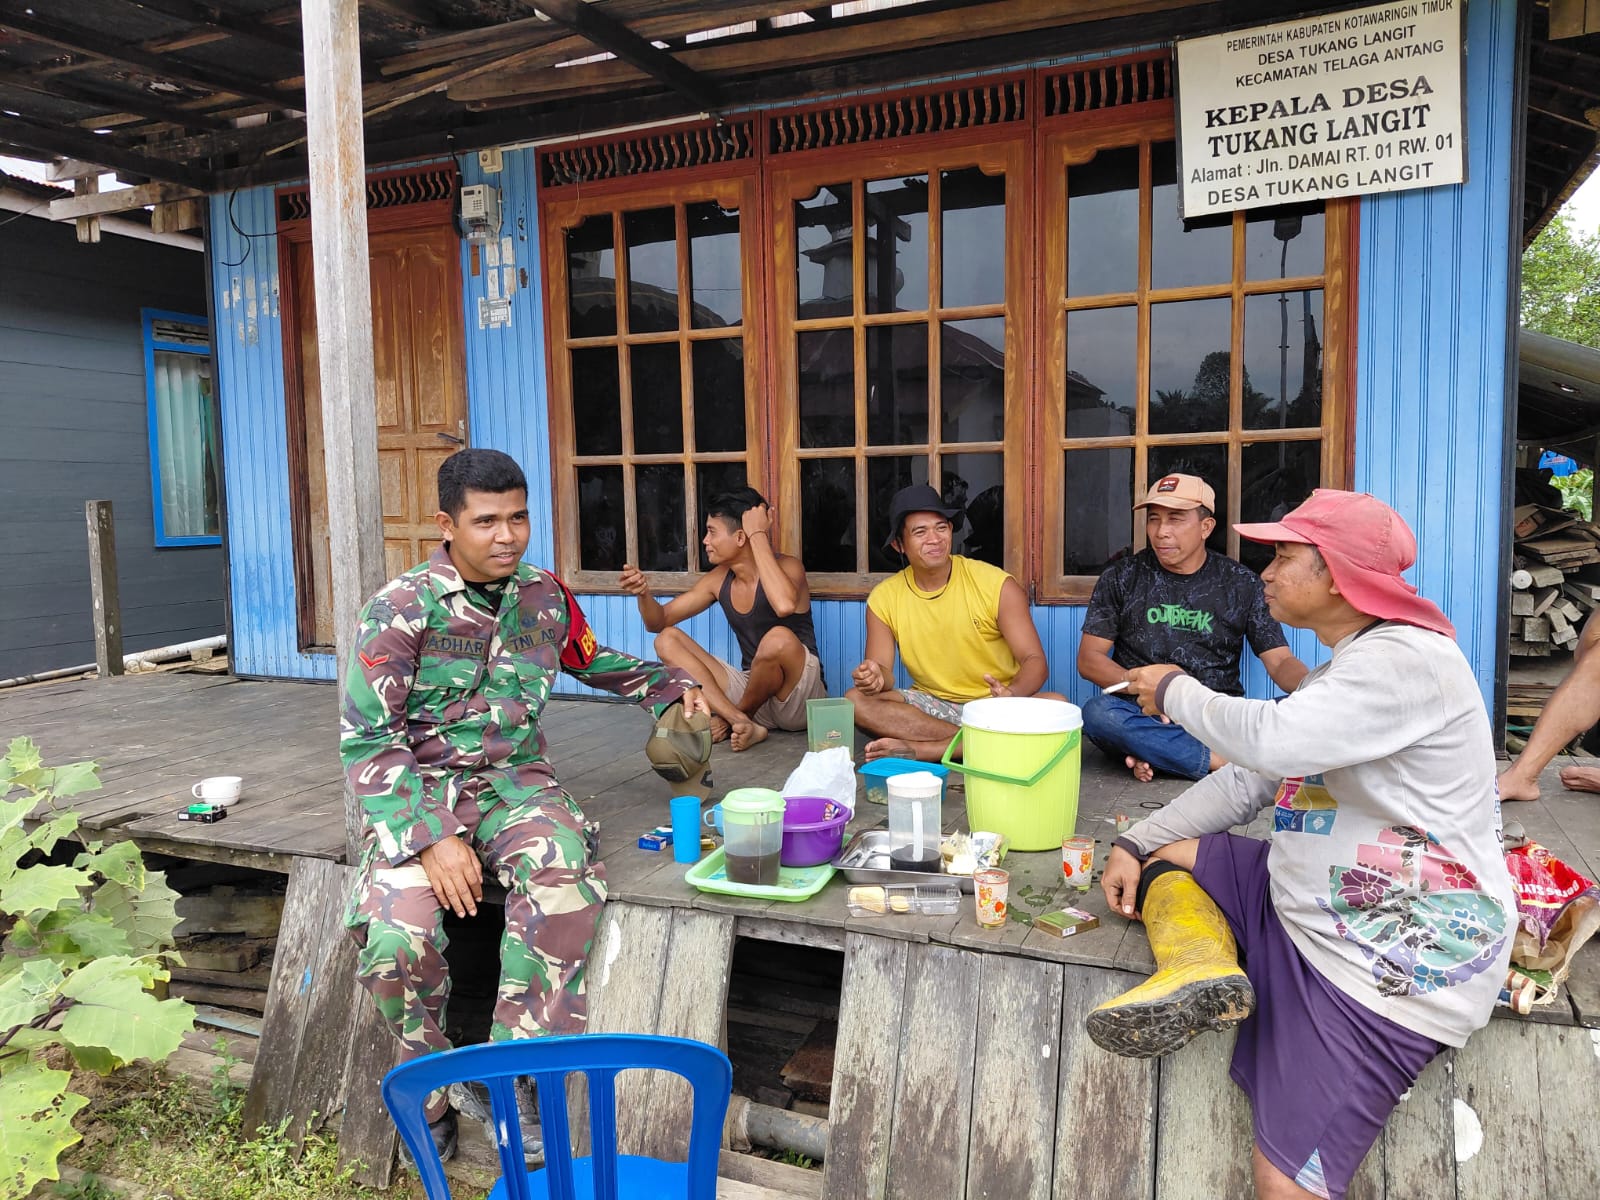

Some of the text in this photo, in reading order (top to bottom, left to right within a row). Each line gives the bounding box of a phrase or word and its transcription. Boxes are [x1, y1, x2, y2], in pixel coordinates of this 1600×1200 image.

[1227, 0, 1453, 52] PEMERINTAH KABUPATEN KOTAWARINGIN TIMUR
[1258, 24, 1417, 66] DESA TUKANG LANGIT
[1235, 39, 1444, 88] KECAMATAN TELAGA ANTANG
[1205, 75, 1433, 128] KEPALA DESA
[1208, 103, 1431, 158] TUKANG LANGIT
[1191, 162, 1242, 184] Alamat
[1288, 149, 1341, 170] DAMAI
[1346, 146, 1369, 163] RT.
[1375, 141, 1393, 160] 01
[1399, 138, 1430, 156] RW.
[1435, 133, 1453, 151] 01
[1208, 162, 1434, 206] DESA TUKANG LANGIT
[511, 634, 534, 651] TNI
[1147, 603, 1214, 633] OUTBREAK
